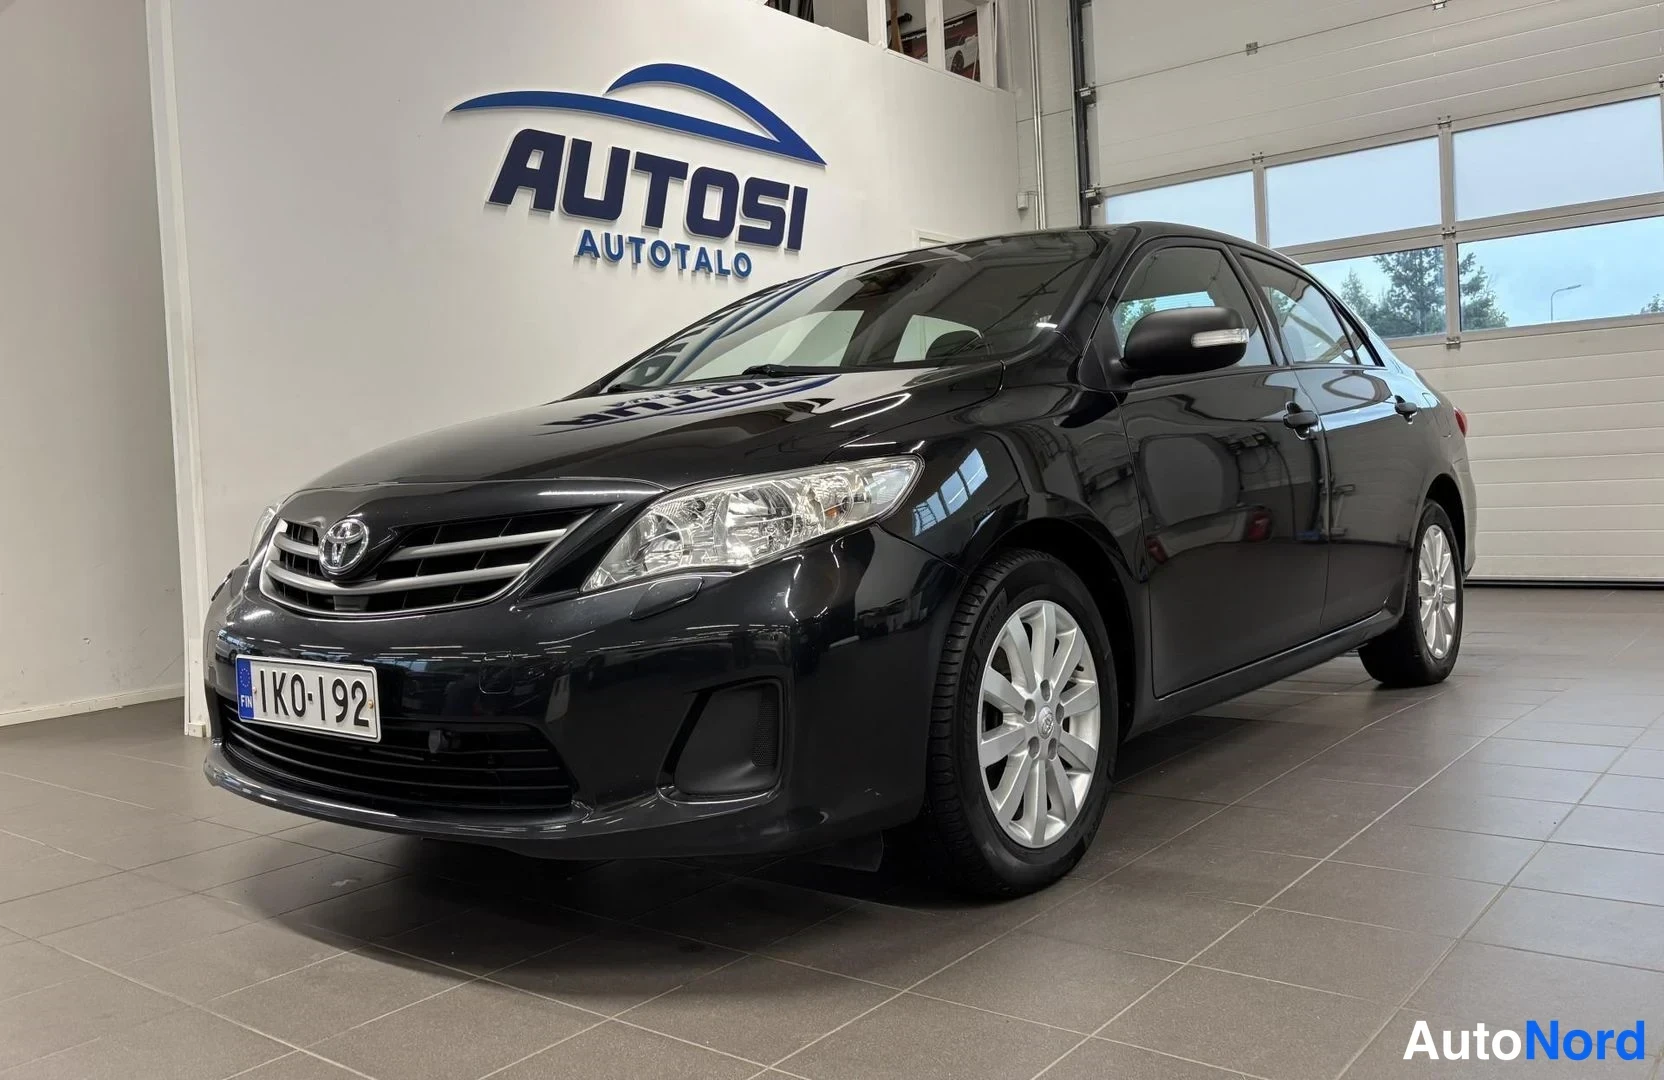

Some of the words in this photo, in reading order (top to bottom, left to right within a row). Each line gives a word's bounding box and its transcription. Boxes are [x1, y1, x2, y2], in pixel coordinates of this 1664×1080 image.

[487, 128, 808, 252] AUTOSI
[576, 229, 752, 278] AUTOTALO
[240, 694, 253, 709] FIN
[260, 670, 370, 728] IKO-192
